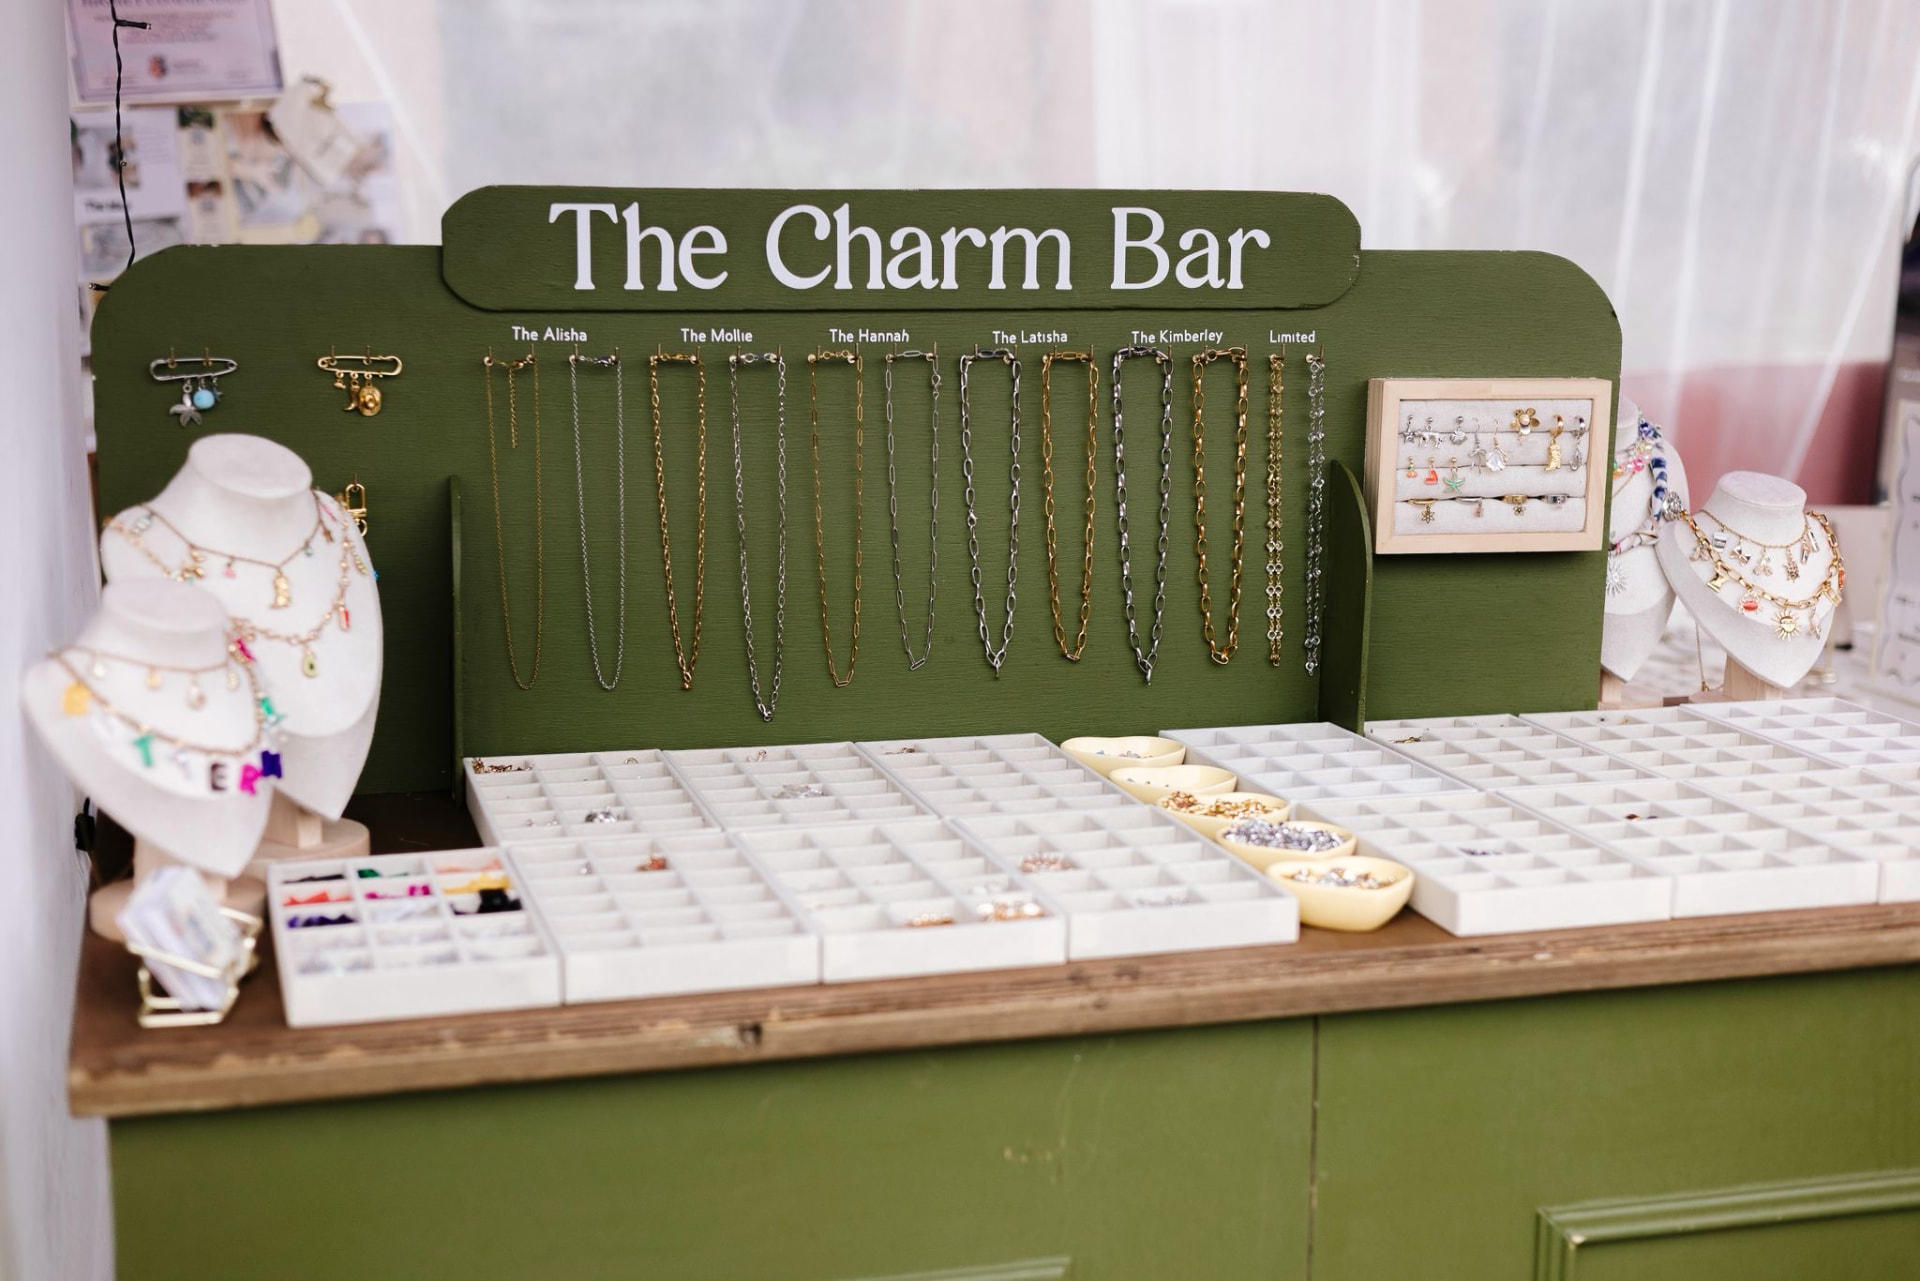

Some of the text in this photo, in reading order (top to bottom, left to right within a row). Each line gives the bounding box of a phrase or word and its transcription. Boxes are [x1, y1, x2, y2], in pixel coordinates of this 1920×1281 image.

[548, 201, 1271, 292] The Charm Bar
[511, 326, 588, 342] The Alisha
[680, 328, 753, 343] The Mollie
[829, 328, 910, 343] The Hannah
[992, 330, 1068, 344] The Latisha
[1131, 328, 1224, 344] The Kimberley
[1269, 329, 1316, 344] Limited
